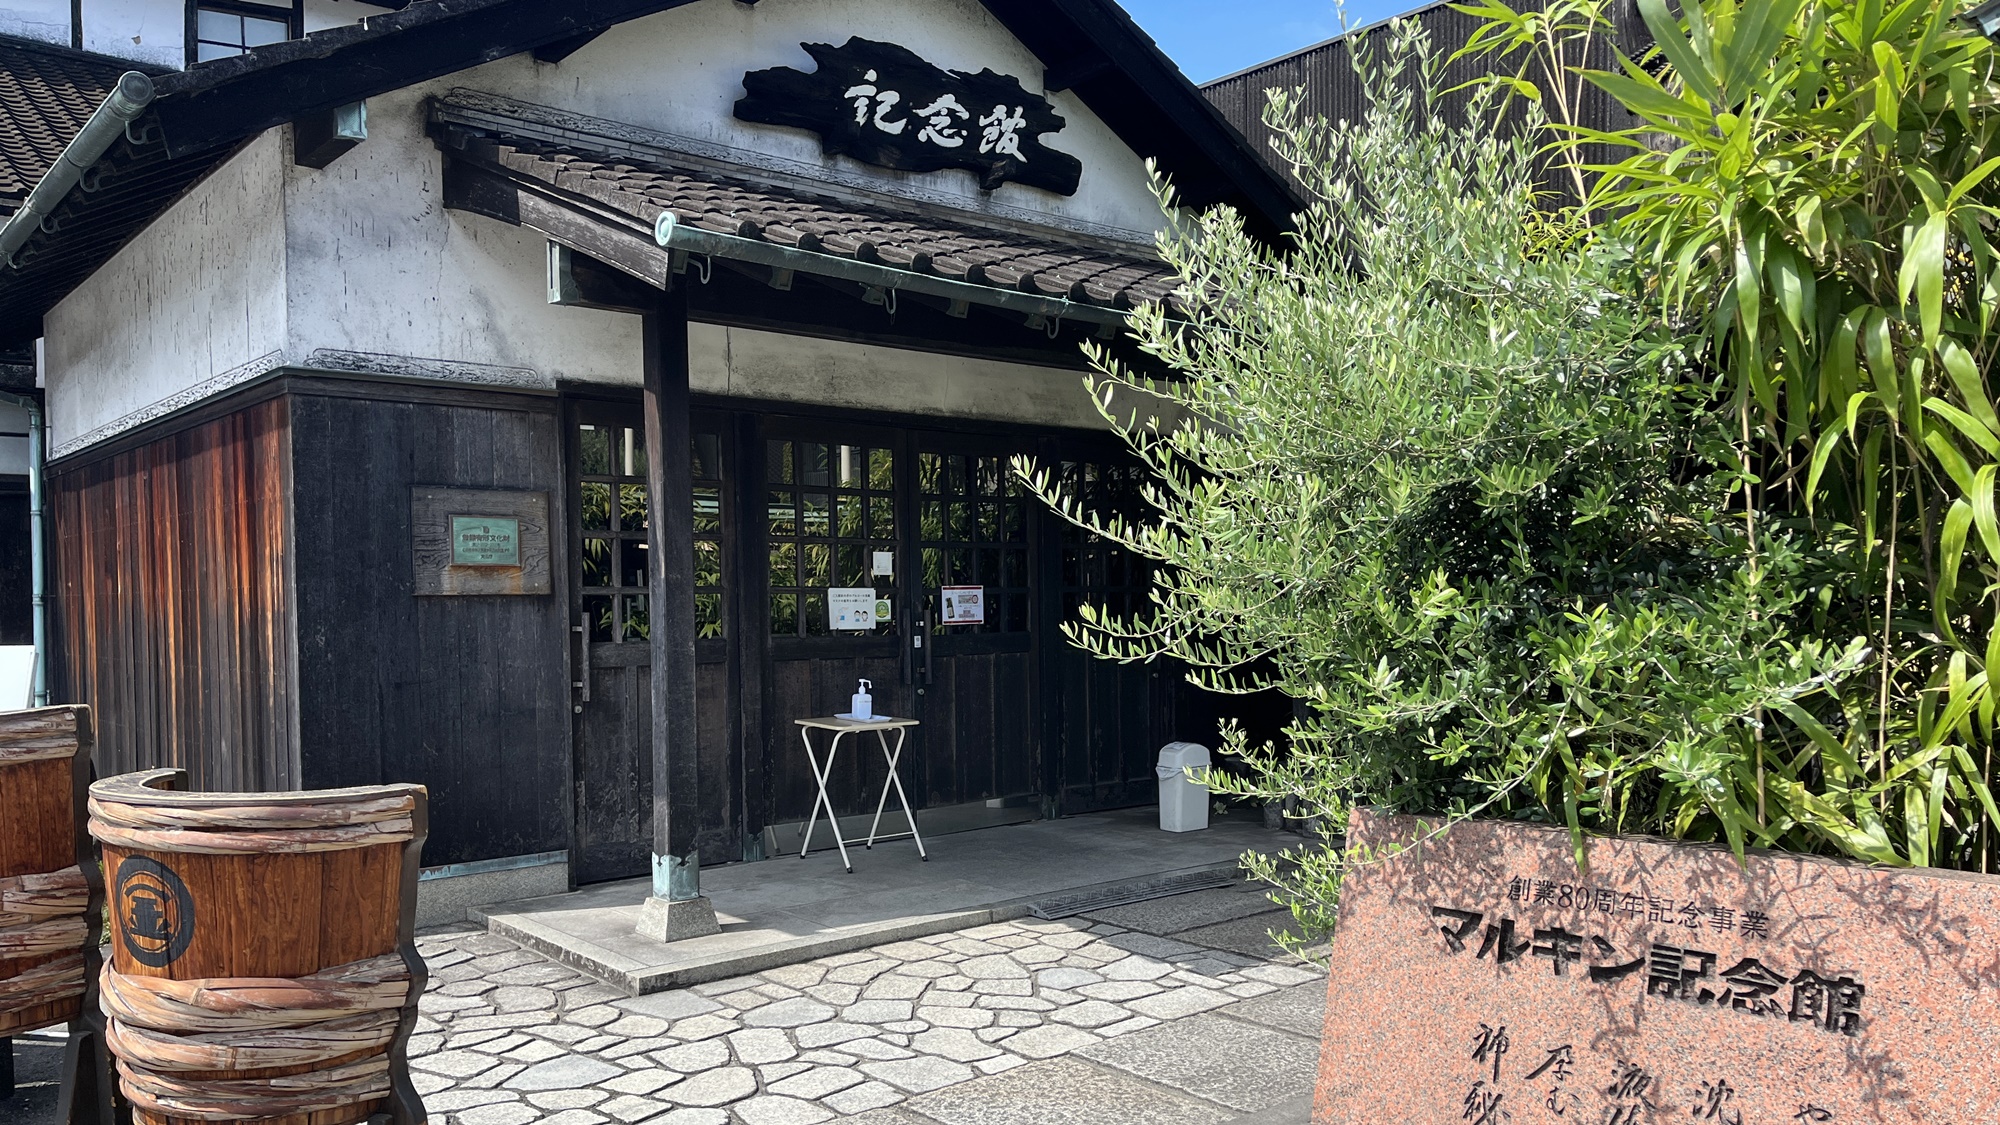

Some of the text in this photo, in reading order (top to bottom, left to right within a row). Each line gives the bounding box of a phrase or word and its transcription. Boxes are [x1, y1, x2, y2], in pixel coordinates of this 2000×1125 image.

[1507, 875, 1770, 940] 創業80周年記念事業
[1432, 905, 1866, 1037] マルキン記念館
